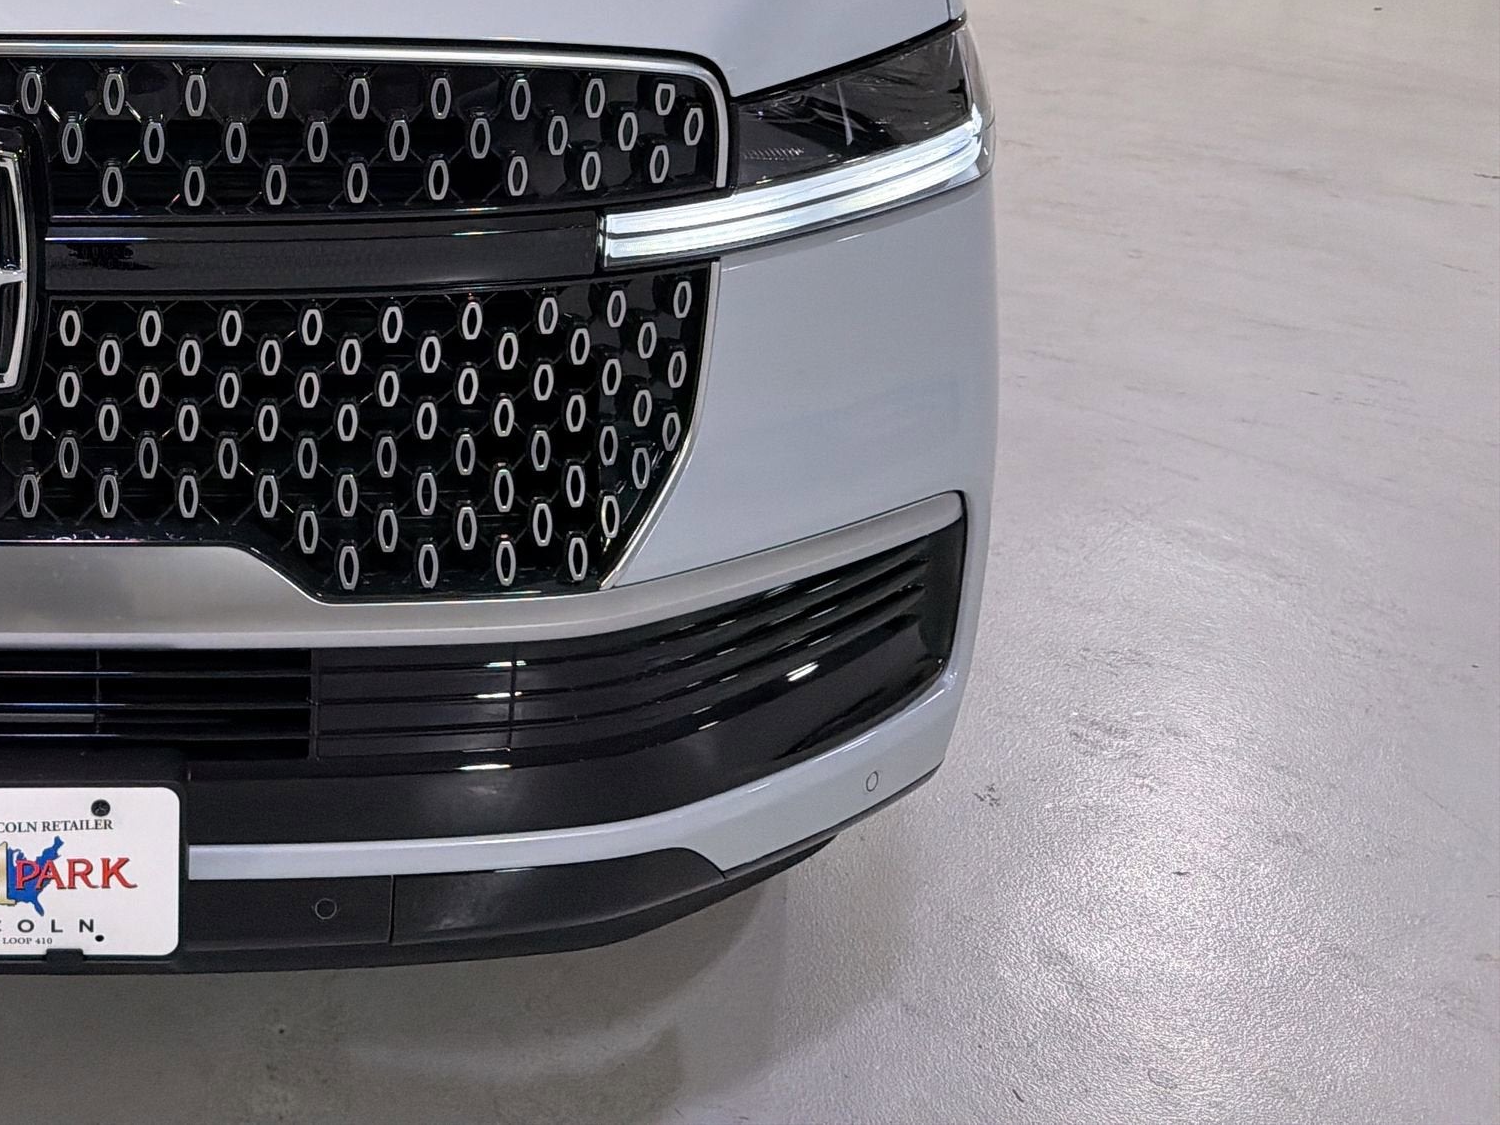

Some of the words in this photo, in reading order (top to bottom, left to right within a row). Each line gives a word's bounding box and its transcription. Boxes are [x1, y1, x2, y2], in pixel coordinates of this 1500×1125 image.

[42, 819, 114, 832] RETAILER
[15, 856, 138, 891] PARK
[3, 937, 32, 945] LOOP
[35, 936, 53, 945] 410
